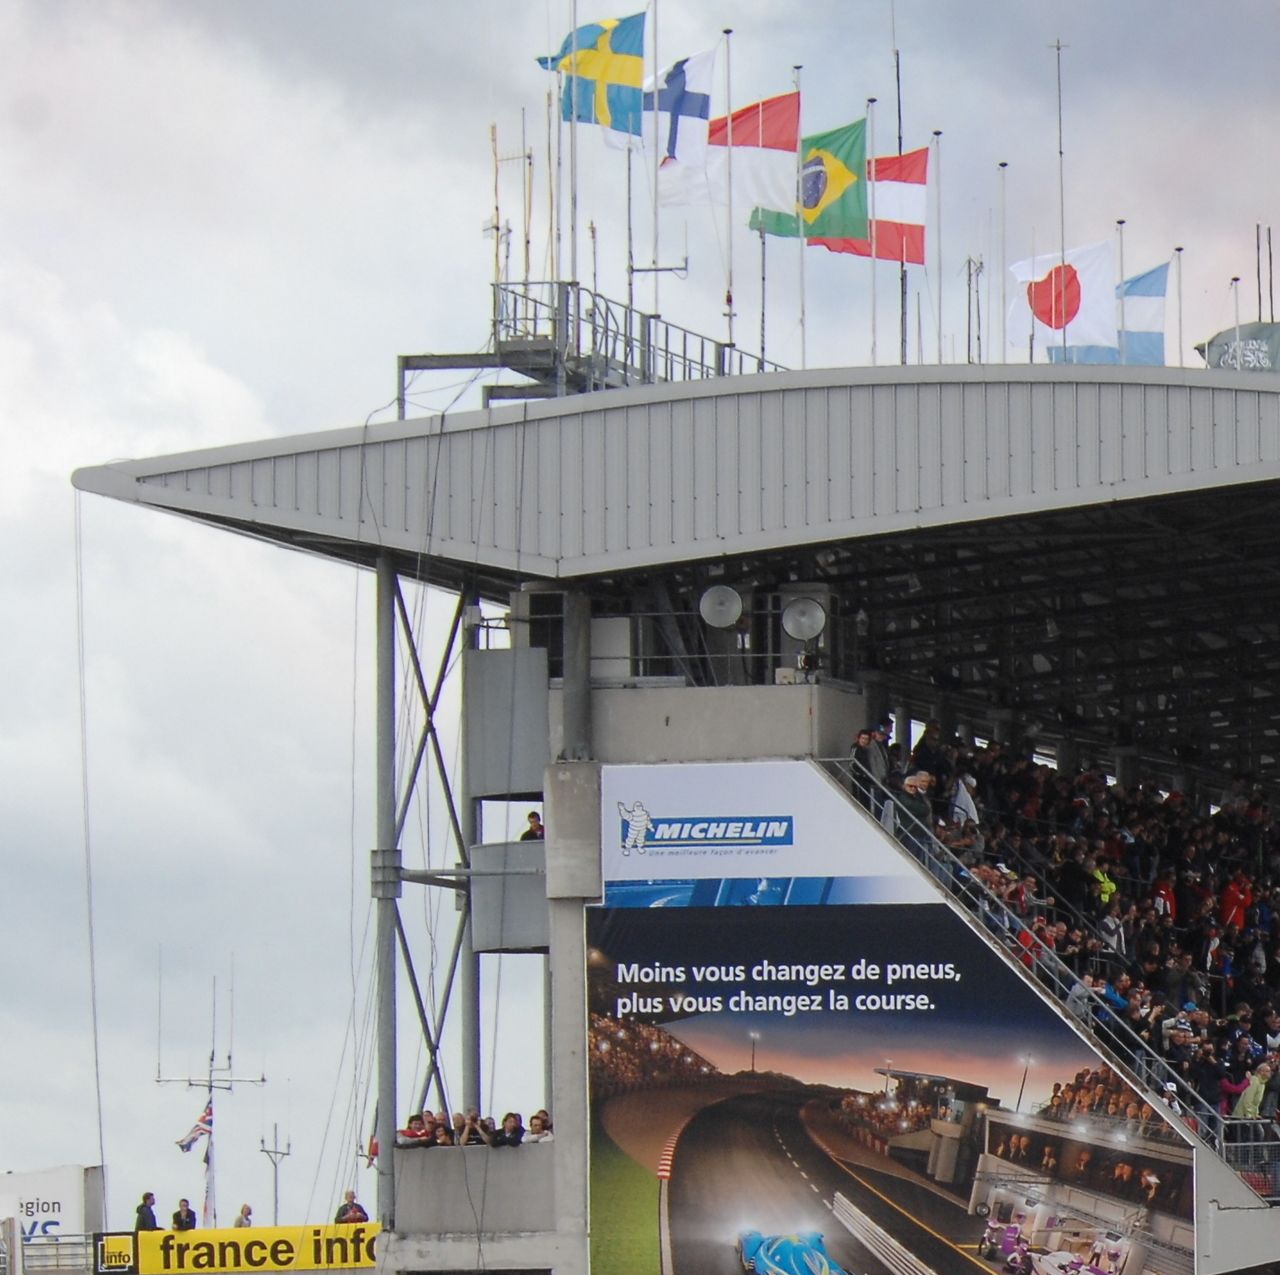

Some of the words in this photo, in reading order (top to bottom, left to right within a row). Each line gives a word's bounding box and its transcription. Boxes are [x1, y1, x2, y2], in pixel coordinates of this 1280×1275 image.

[654, 822, 788, 840] MICHELIN
[617, 963, 686, 983] Moins
[691, 965, 745, 982] vous
[752, 960, 846, 986] changez
[852, 959, 880, 980] de
[887, 962, 961, 984] pneus,
[617, 993, 663, 1018] plus
[673, 996, 722, 1012] vous
[729, 991, 822, 1016] changez
[829, 990, 849, 1010] la
[855, 994, 935, 1010] course.
[106, 1251, 131, 1264] info
[160, 1234, 295, 1270] france
